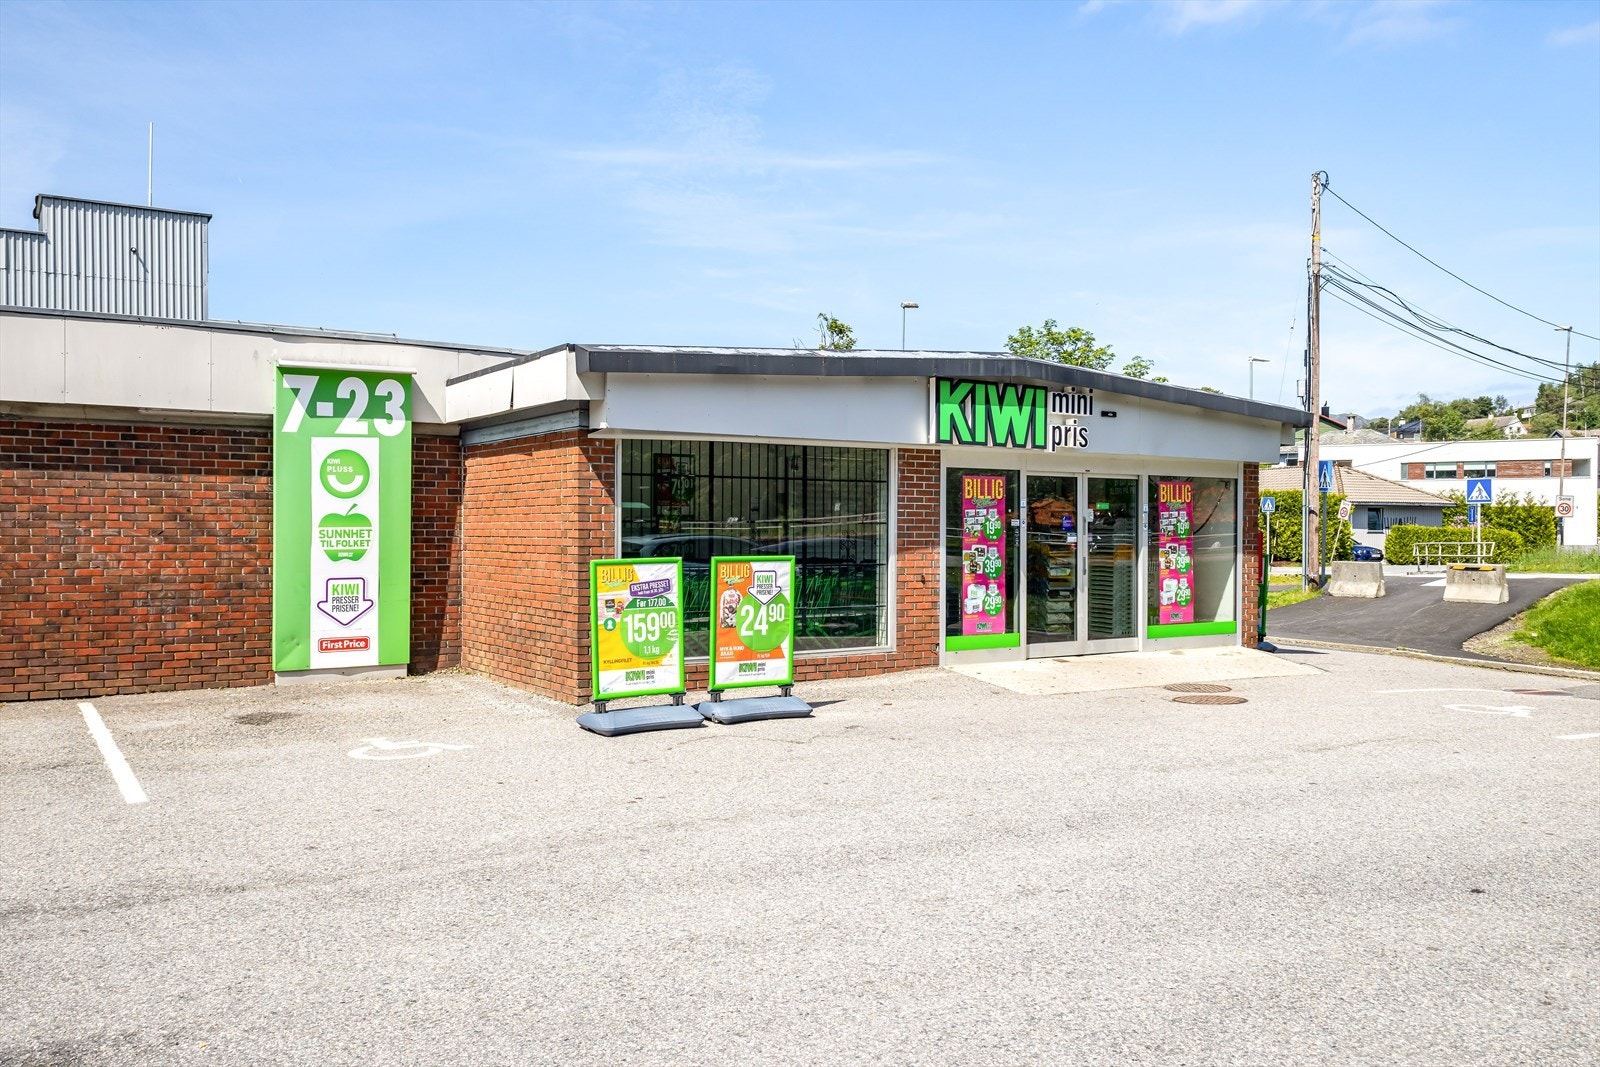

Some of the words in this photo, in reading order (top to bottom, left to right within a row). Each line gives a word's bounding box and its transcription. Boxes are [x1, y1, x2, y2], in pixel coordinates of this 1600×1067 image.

[281, 373, 406, 437] 7-23
[1052, 386, 1094, 416] mini
[937, 377, 1047, 449] KIWI
[1052, 419, 1089, 452] pris
[327, 465, 354, 473] PLUSS
[964, 478, 1004, 499] BILLIG
[1160, 484, 1192, 503] BILLIG
[318, 528, 372, 539] SUNNHET
[320, 539, 334, 548] TIL
[335, 539, 371, 548] FOLKET
[601, 567, 634, 584] BILLIG
[720, 564, 750, 578] BILLIG
[756, 574, 774, 584] KIWI
[332, 583, 360, 596] KIWI
[332, 595, 359, 604] PRESSER
[648, 598, 667, 608] 177,00
[332, 603, 359, 613] PRISENE!
[322, 640, 343, 650] First
[343, 639, 366, 649] Price
[651, 645, 660, 655] kg
[603, 657, 633, 665] KYLLINGFILET
[738, 662, 757, 673] KIWI
[625, 669, 646, 682] KIWI
